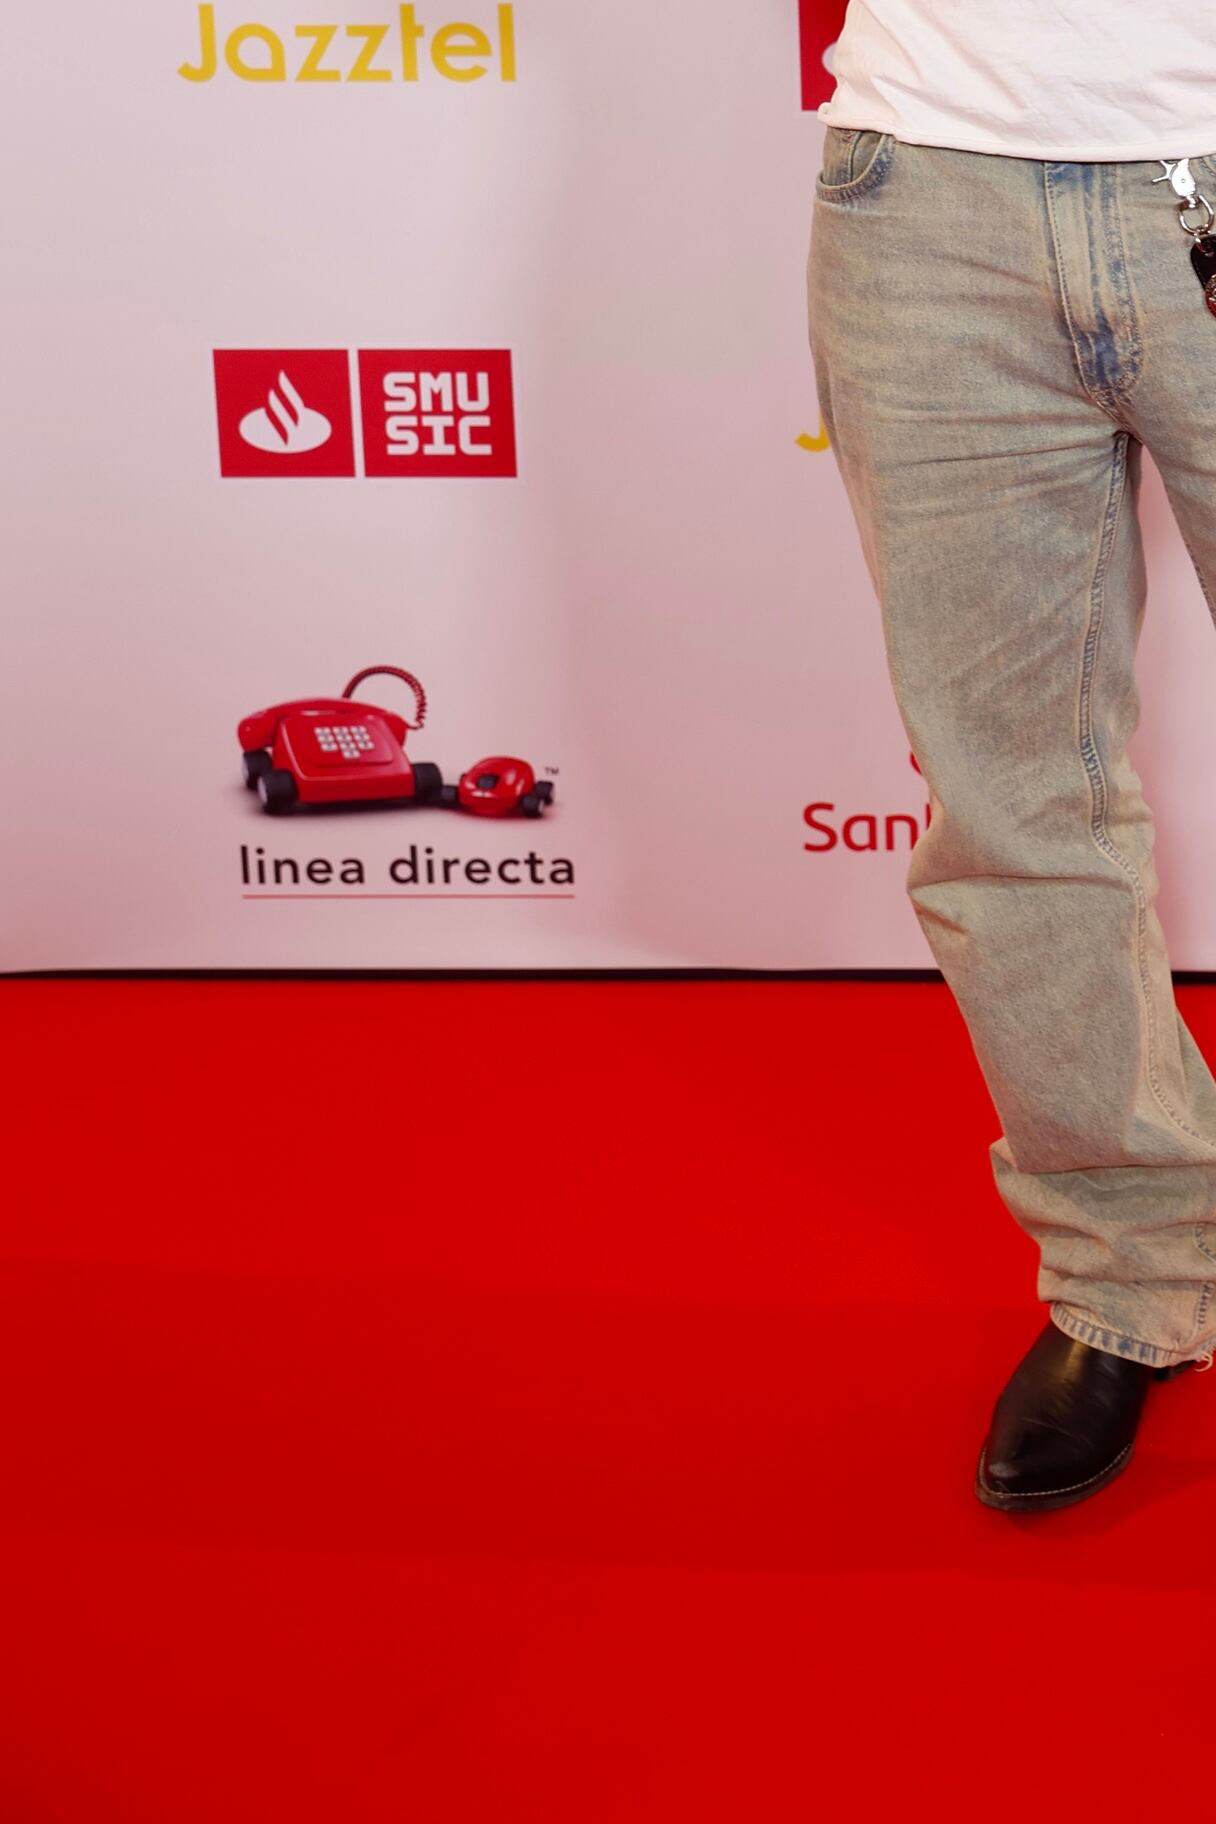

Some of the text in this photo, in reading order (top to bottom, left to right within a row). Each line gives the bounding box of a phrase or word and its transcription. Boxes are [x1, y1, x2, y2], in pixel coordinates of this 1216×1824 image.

[179, 3, 517, 83] Jazztel
[384, 372, 491, 413] SMU
[386, 414, 493, 456] SIC
[803, 802, 932, 852] San
[241, 845, 576, 886] linea directa
